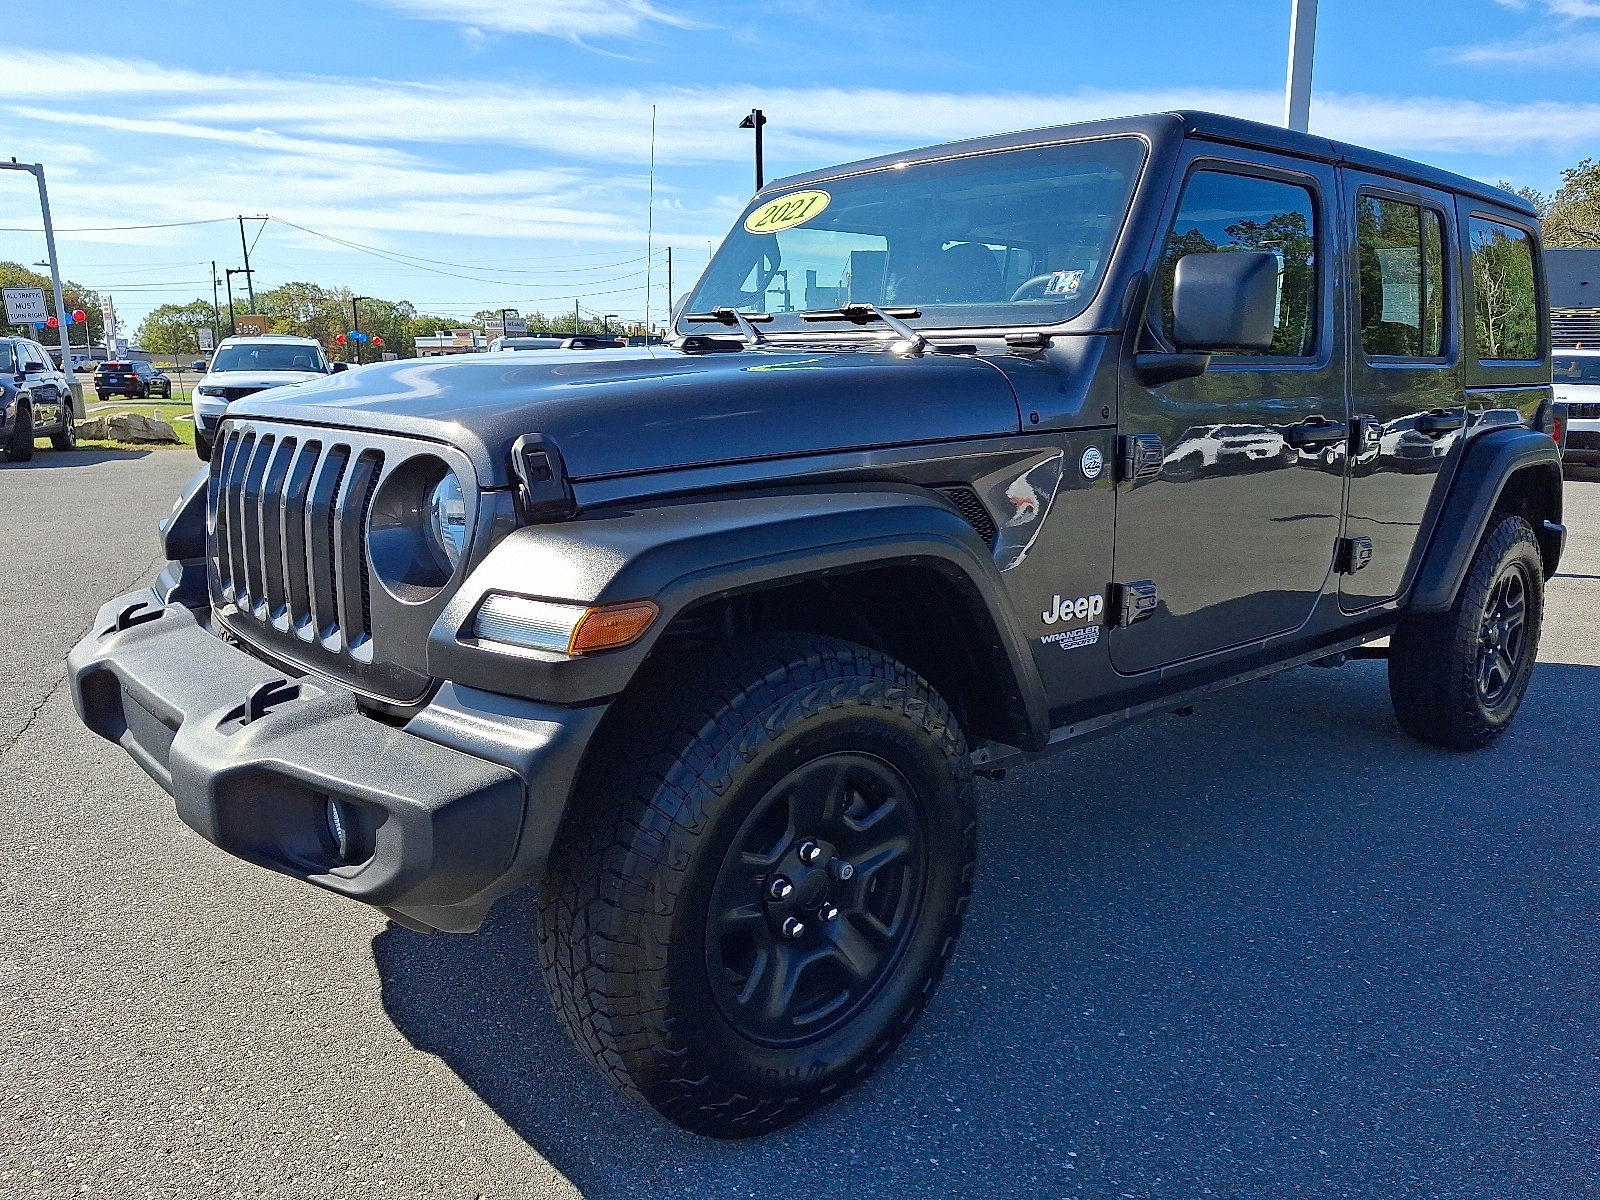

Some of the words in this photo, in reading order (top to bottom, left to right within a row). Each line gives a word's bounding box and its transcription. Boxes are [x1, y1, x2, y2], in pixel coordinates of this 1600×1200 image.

[755, 196, 819, 227] 2021
[15, 302, 36, 310] MUST
[234, 322, 261, 335] Jeep
[1041, 594, 1104, 625] Jeep
[1041, 625, 1100, 644] WRANGLER
